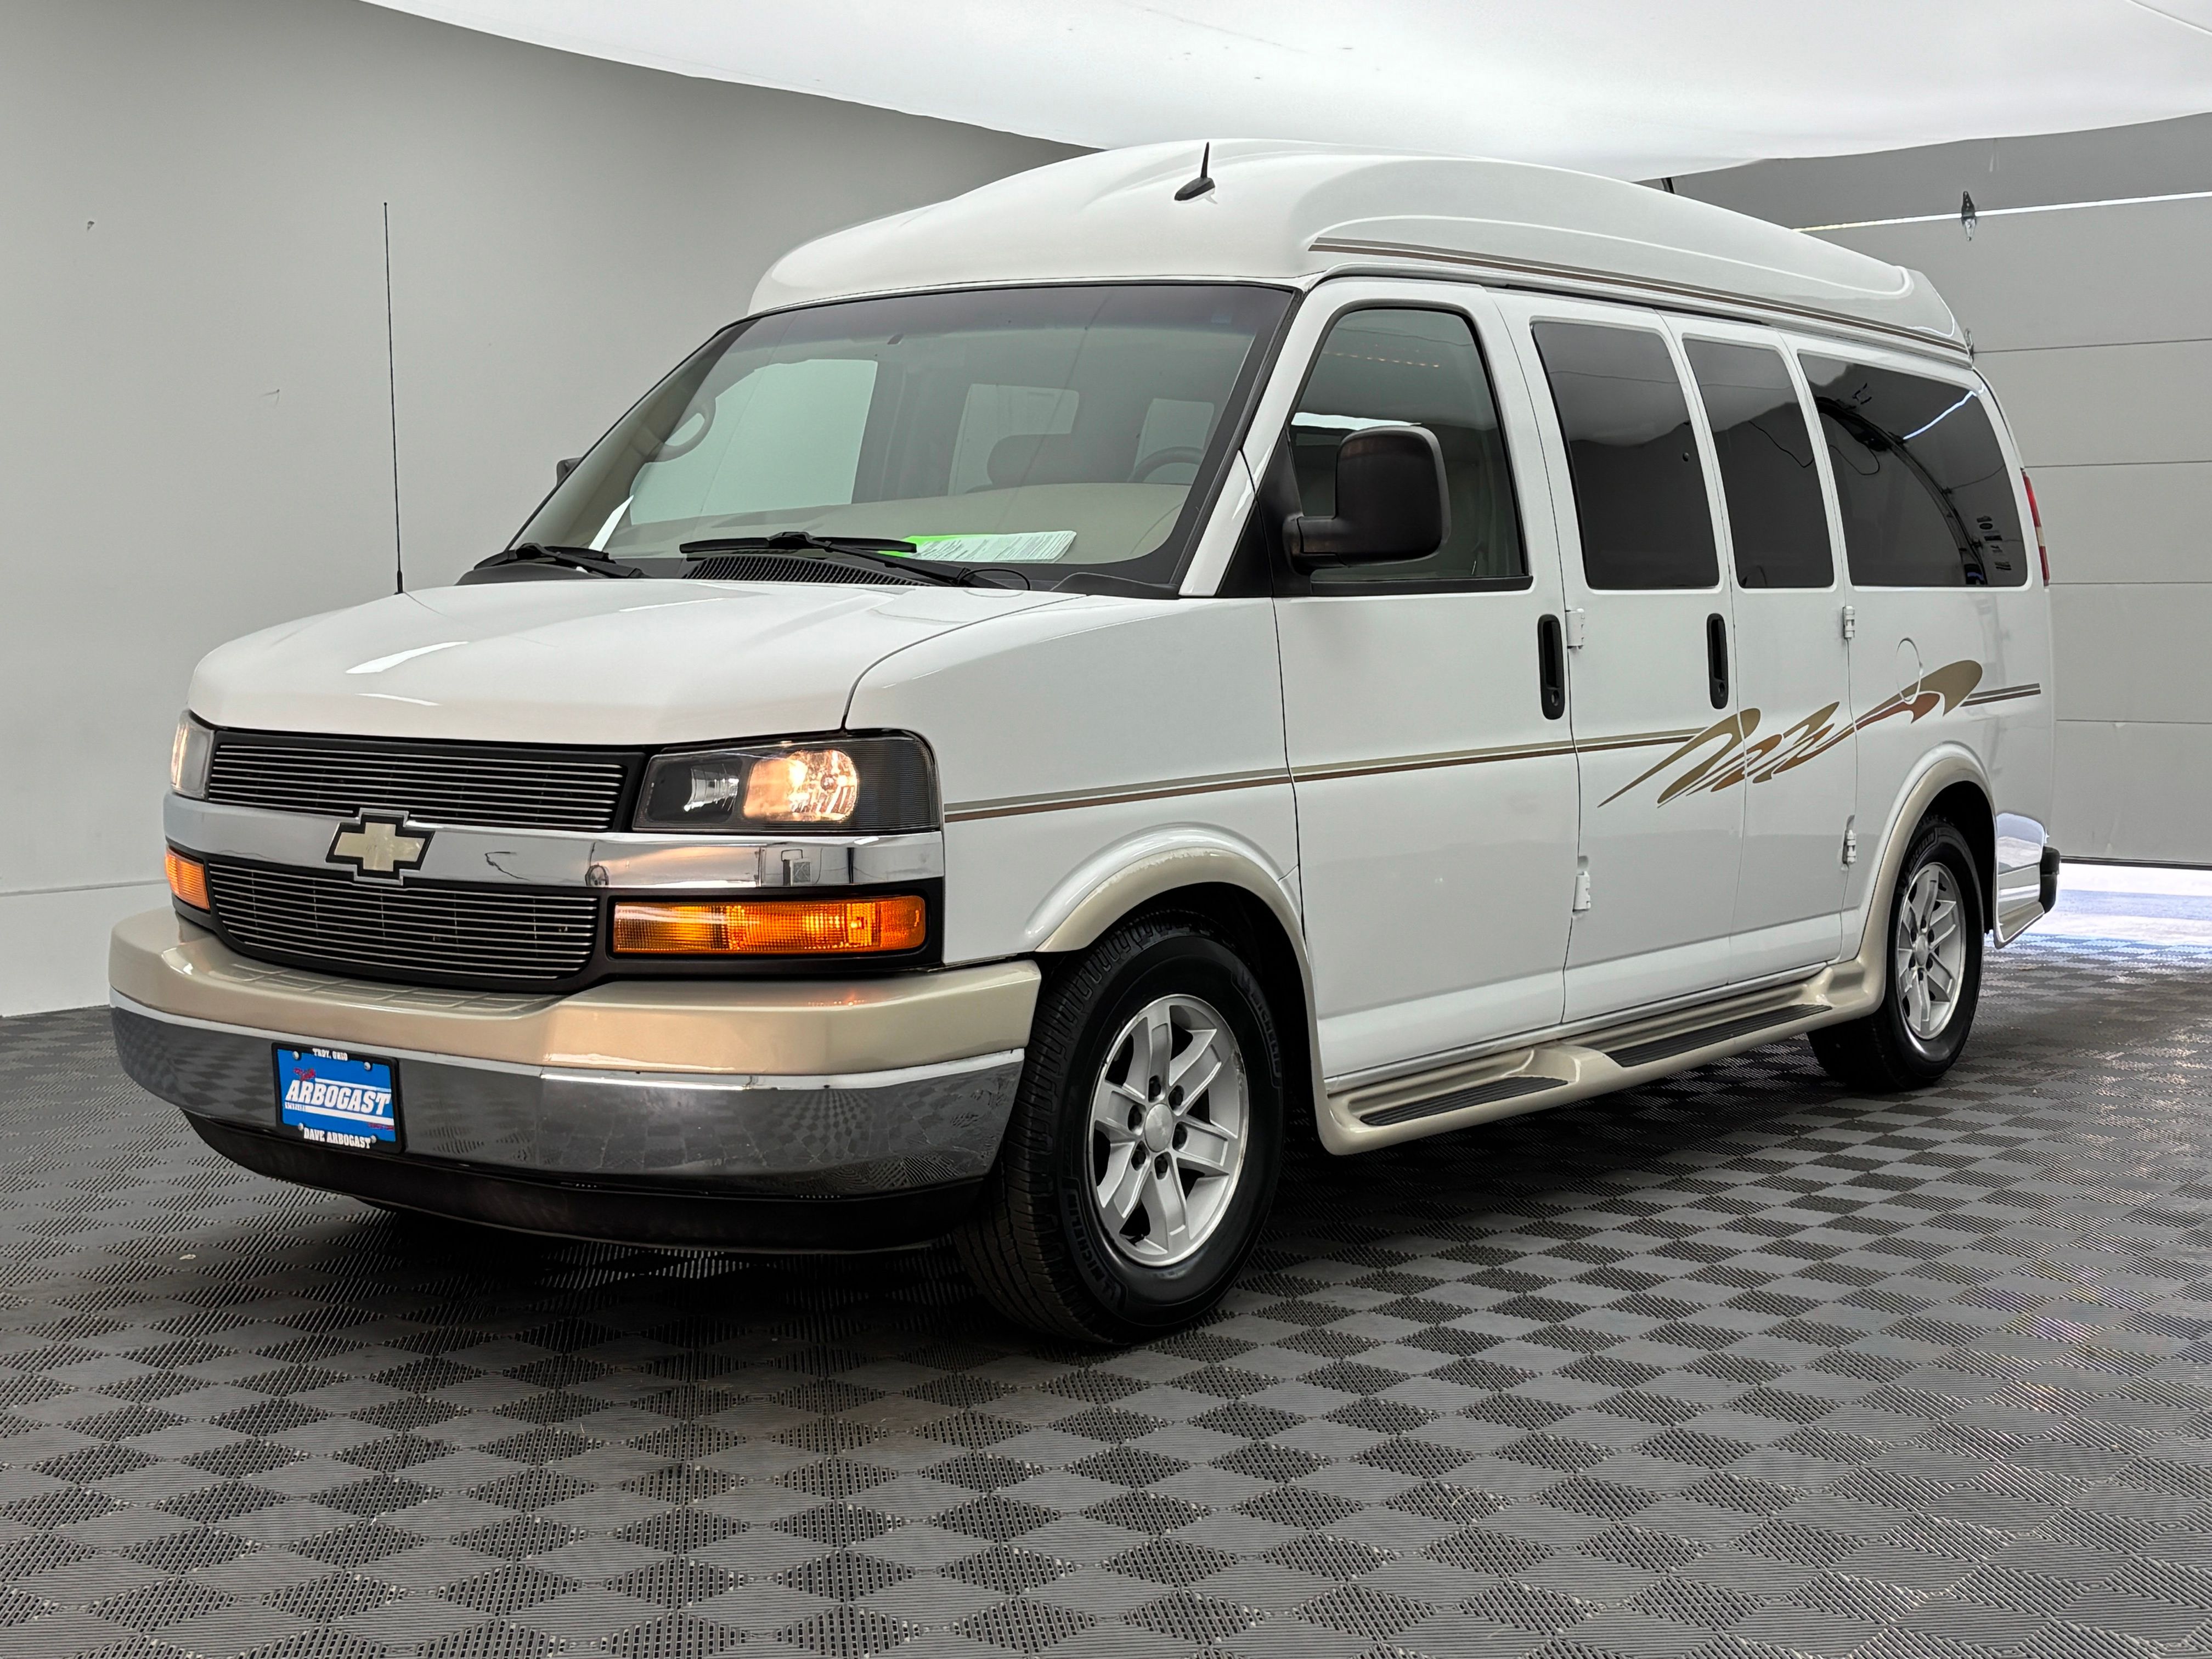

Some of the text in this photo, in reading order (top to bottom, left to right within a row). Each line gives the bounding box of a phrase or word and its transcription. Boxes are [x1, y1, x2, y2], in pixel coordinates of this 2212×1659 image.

[285, 1080, 391, 1115] ARBOGAST
[304, 1127, 371, 1149] DAVE ARBOGAST
